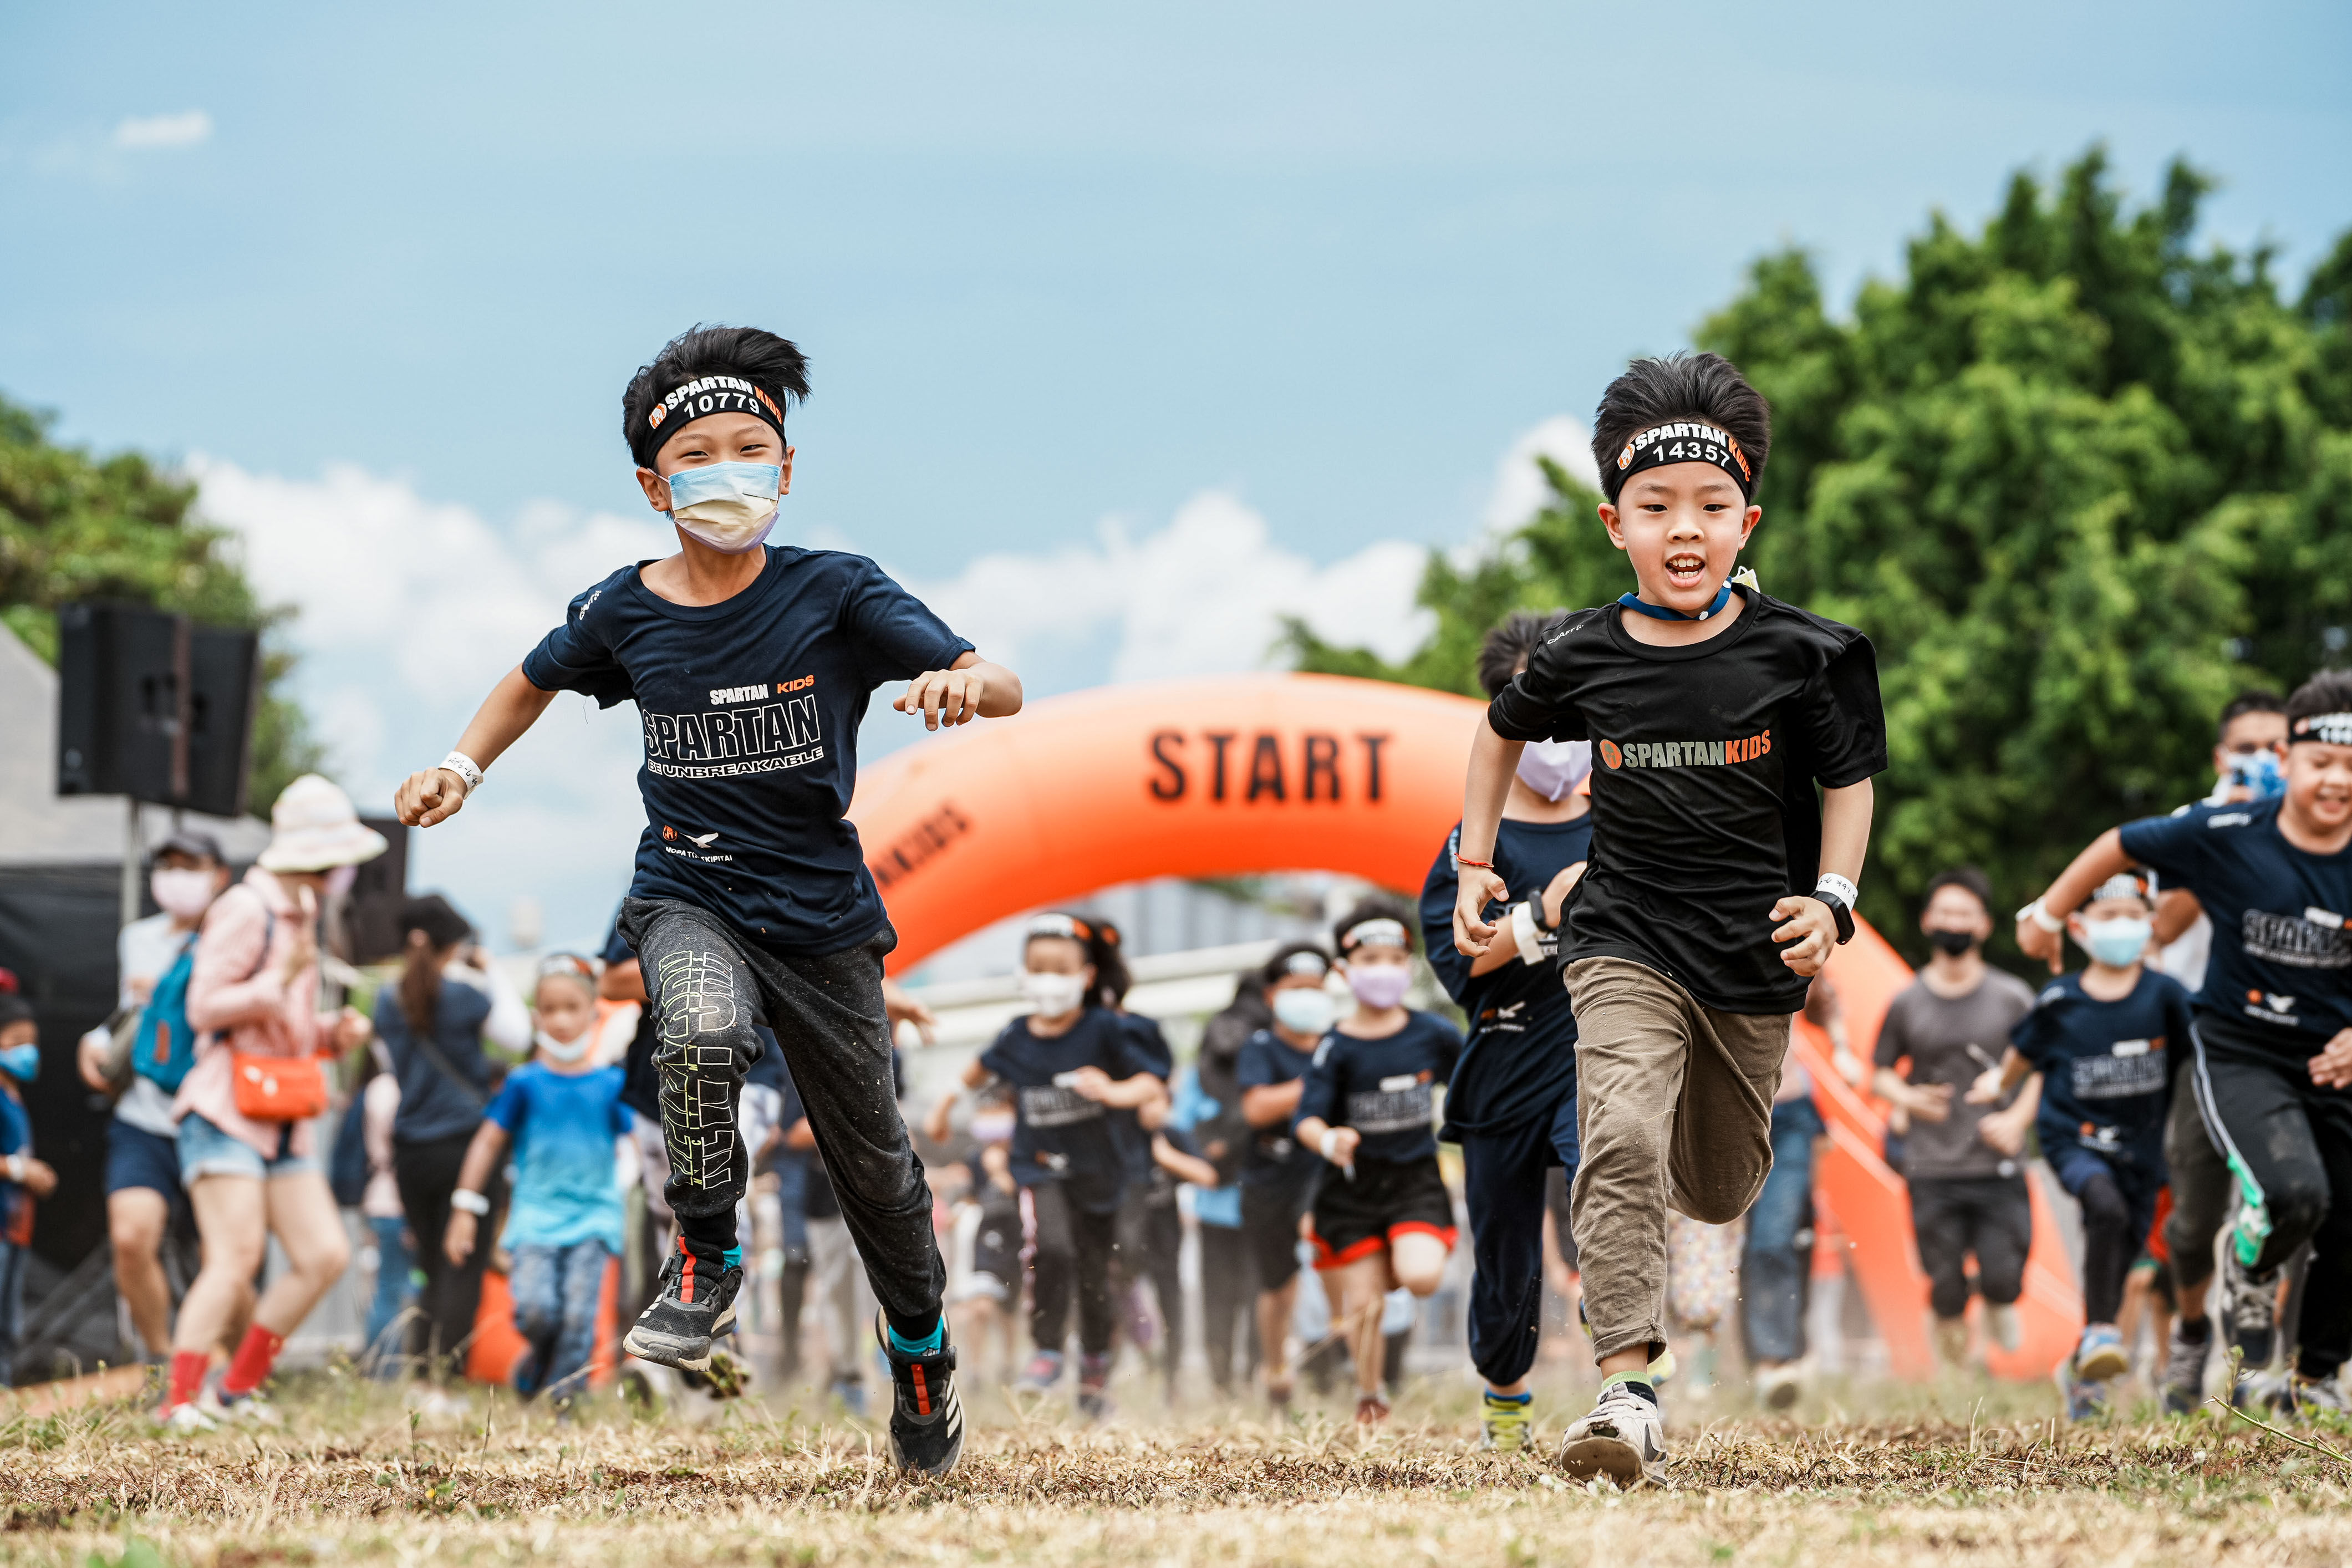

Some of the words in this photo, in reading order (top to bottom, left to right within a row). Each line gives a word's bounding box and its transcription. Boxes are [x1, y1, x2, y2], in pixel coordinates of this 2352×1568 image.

[665, 376, 753, 410] SPARTAN
[684, 393, 760, 418] 10779
[1635, 423, 1727, 451] SPARTAN
[1653, 442, 1730, 467] 14357
[710, 684, 769, 705] SPARTAN
[777, 675, 814, 694] KIDS
[643, 694, 822, 761] SPARTAN
[1149, 731, 1393, 803] START
[689, 957, 704, 1014] RULES
[686, 1043, 699, 1071] MY
[688, 1094, 702, 1146] CITY
